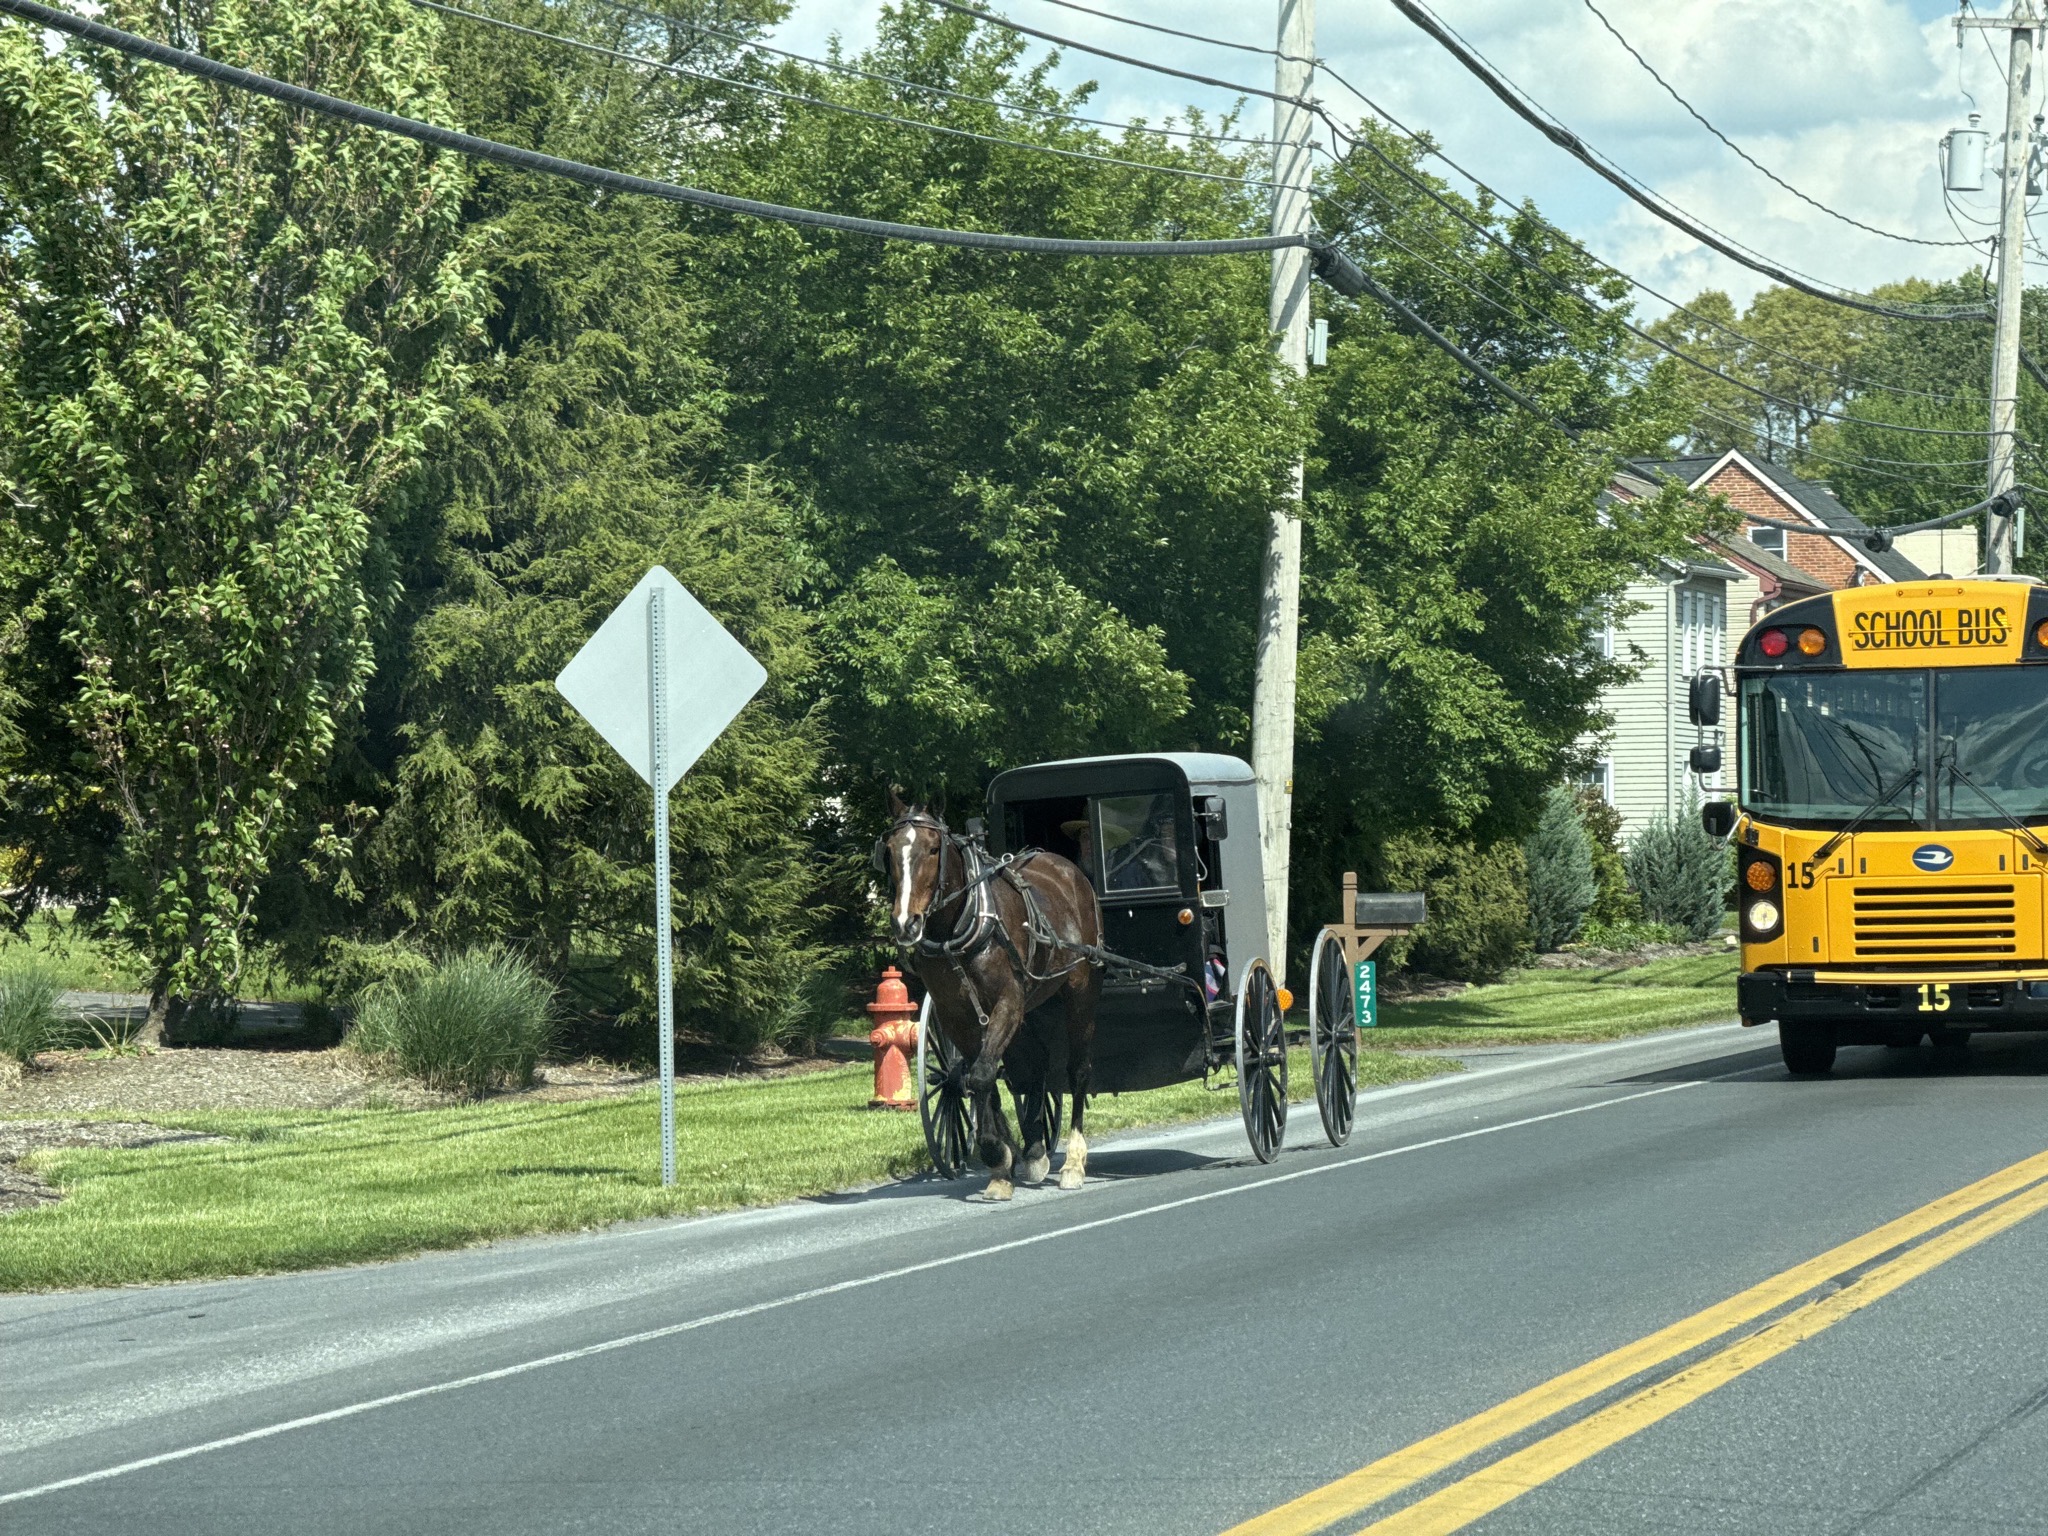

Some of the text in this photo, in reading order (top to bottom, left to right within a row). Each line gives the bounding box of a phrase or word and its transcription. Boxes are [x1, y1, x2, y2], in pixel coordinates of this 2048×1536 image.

[1854, 607, 2007, 649] SCHOOL BUS
[1787, 862, 1814, 890] 15
[1359, 965, 1372, 1024] 2473
[1918, 984, 1951, 1011] 15
